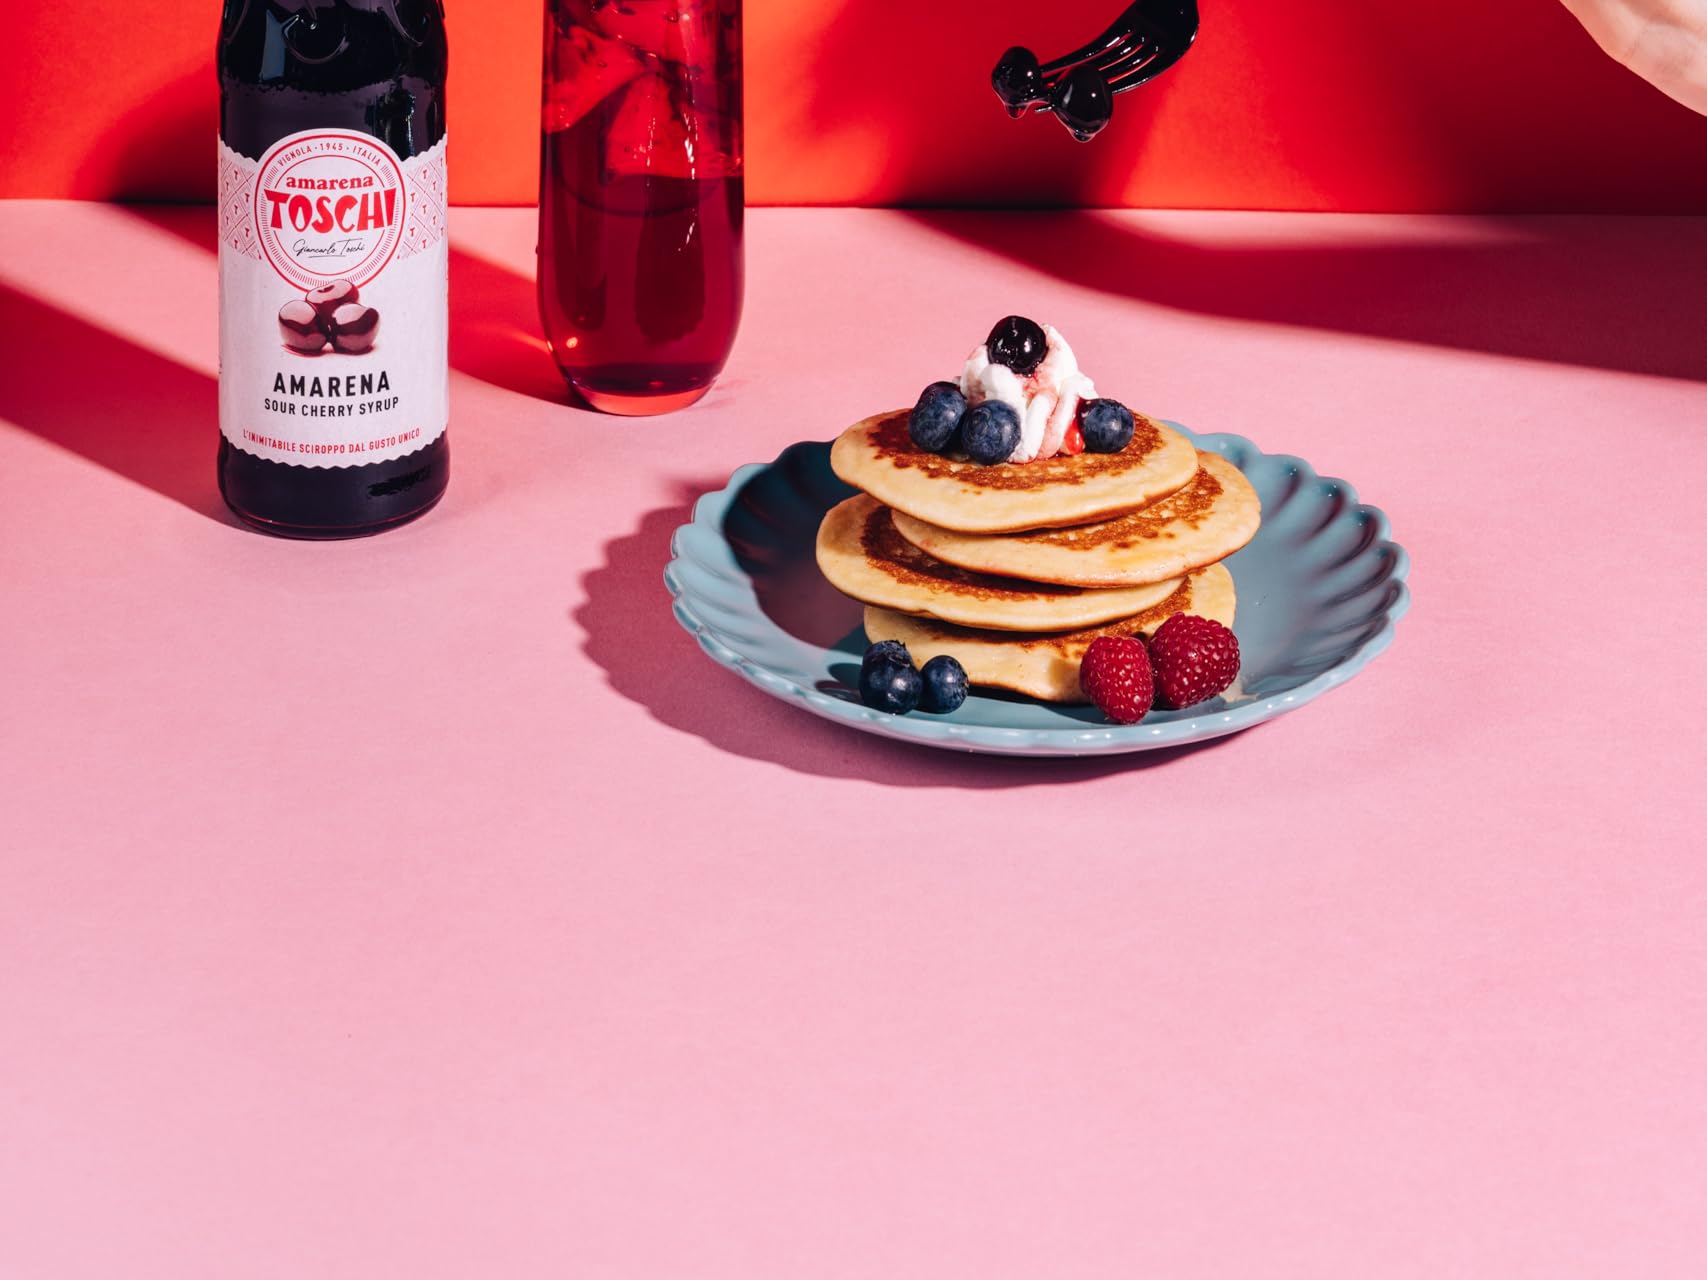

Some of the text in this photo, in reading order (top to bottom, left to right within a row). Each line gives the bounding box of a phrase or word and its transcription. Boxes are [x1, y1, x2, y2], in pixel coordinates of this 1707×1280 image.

[277, 142, 381, 167] VIGNOLA 1945 ITALIA
[285, 175, 374, 190] amarena
[264, 187, 397, 234] TOSCHI
[292, 238, 365, 257] Giancarlo Toschi
[273, 370, 390, 397] AMARENA
[264, 396, 399, 417] SOUR CHERRY SYRUP
[243, 427, 420, 454] L'INIMITABILE SCIROPPO DAL GUSTO UNICO
